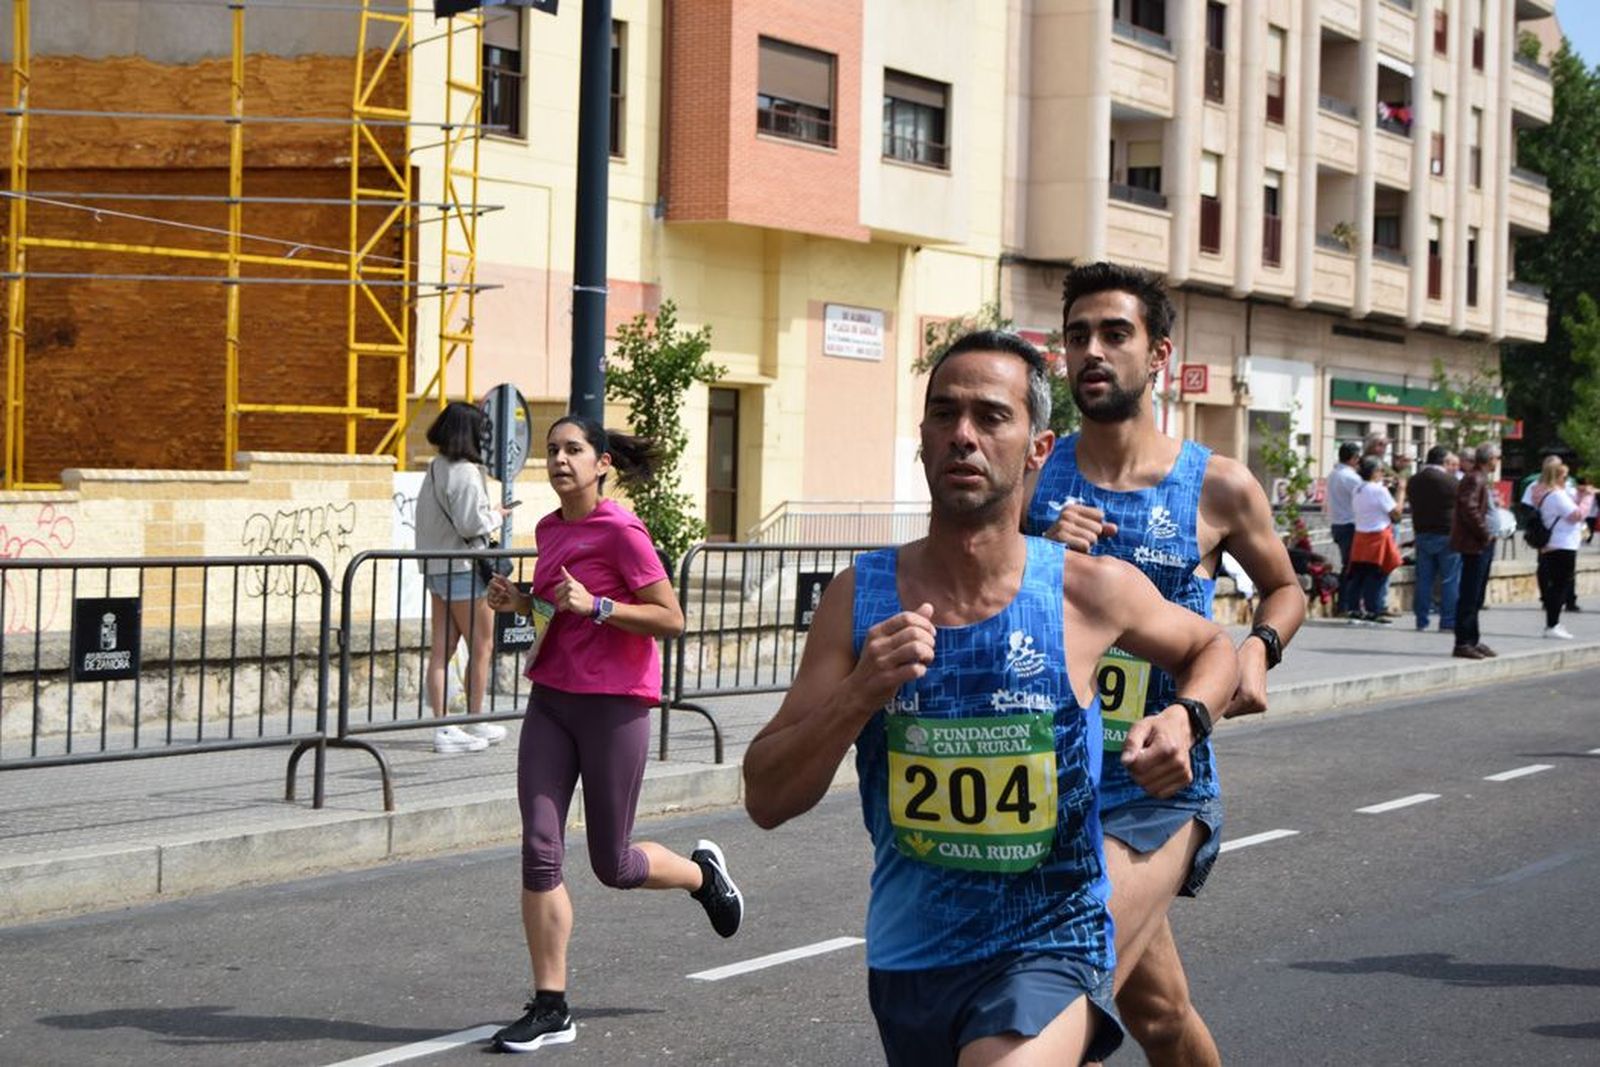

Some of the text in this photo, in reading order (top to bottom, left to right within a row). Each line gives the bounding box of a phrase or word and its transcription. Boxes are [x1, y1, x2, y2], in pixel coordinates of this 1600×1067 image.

[84, 659, 130, 671] DE ZAMORA
[932, 724, 1031, 741] FUNDACION
[932, 739, 1032, 755] CAJA RURAL
[905, 764, 1037, 825] 204
[938, 842, 1045, 860] CAJA RURAL
